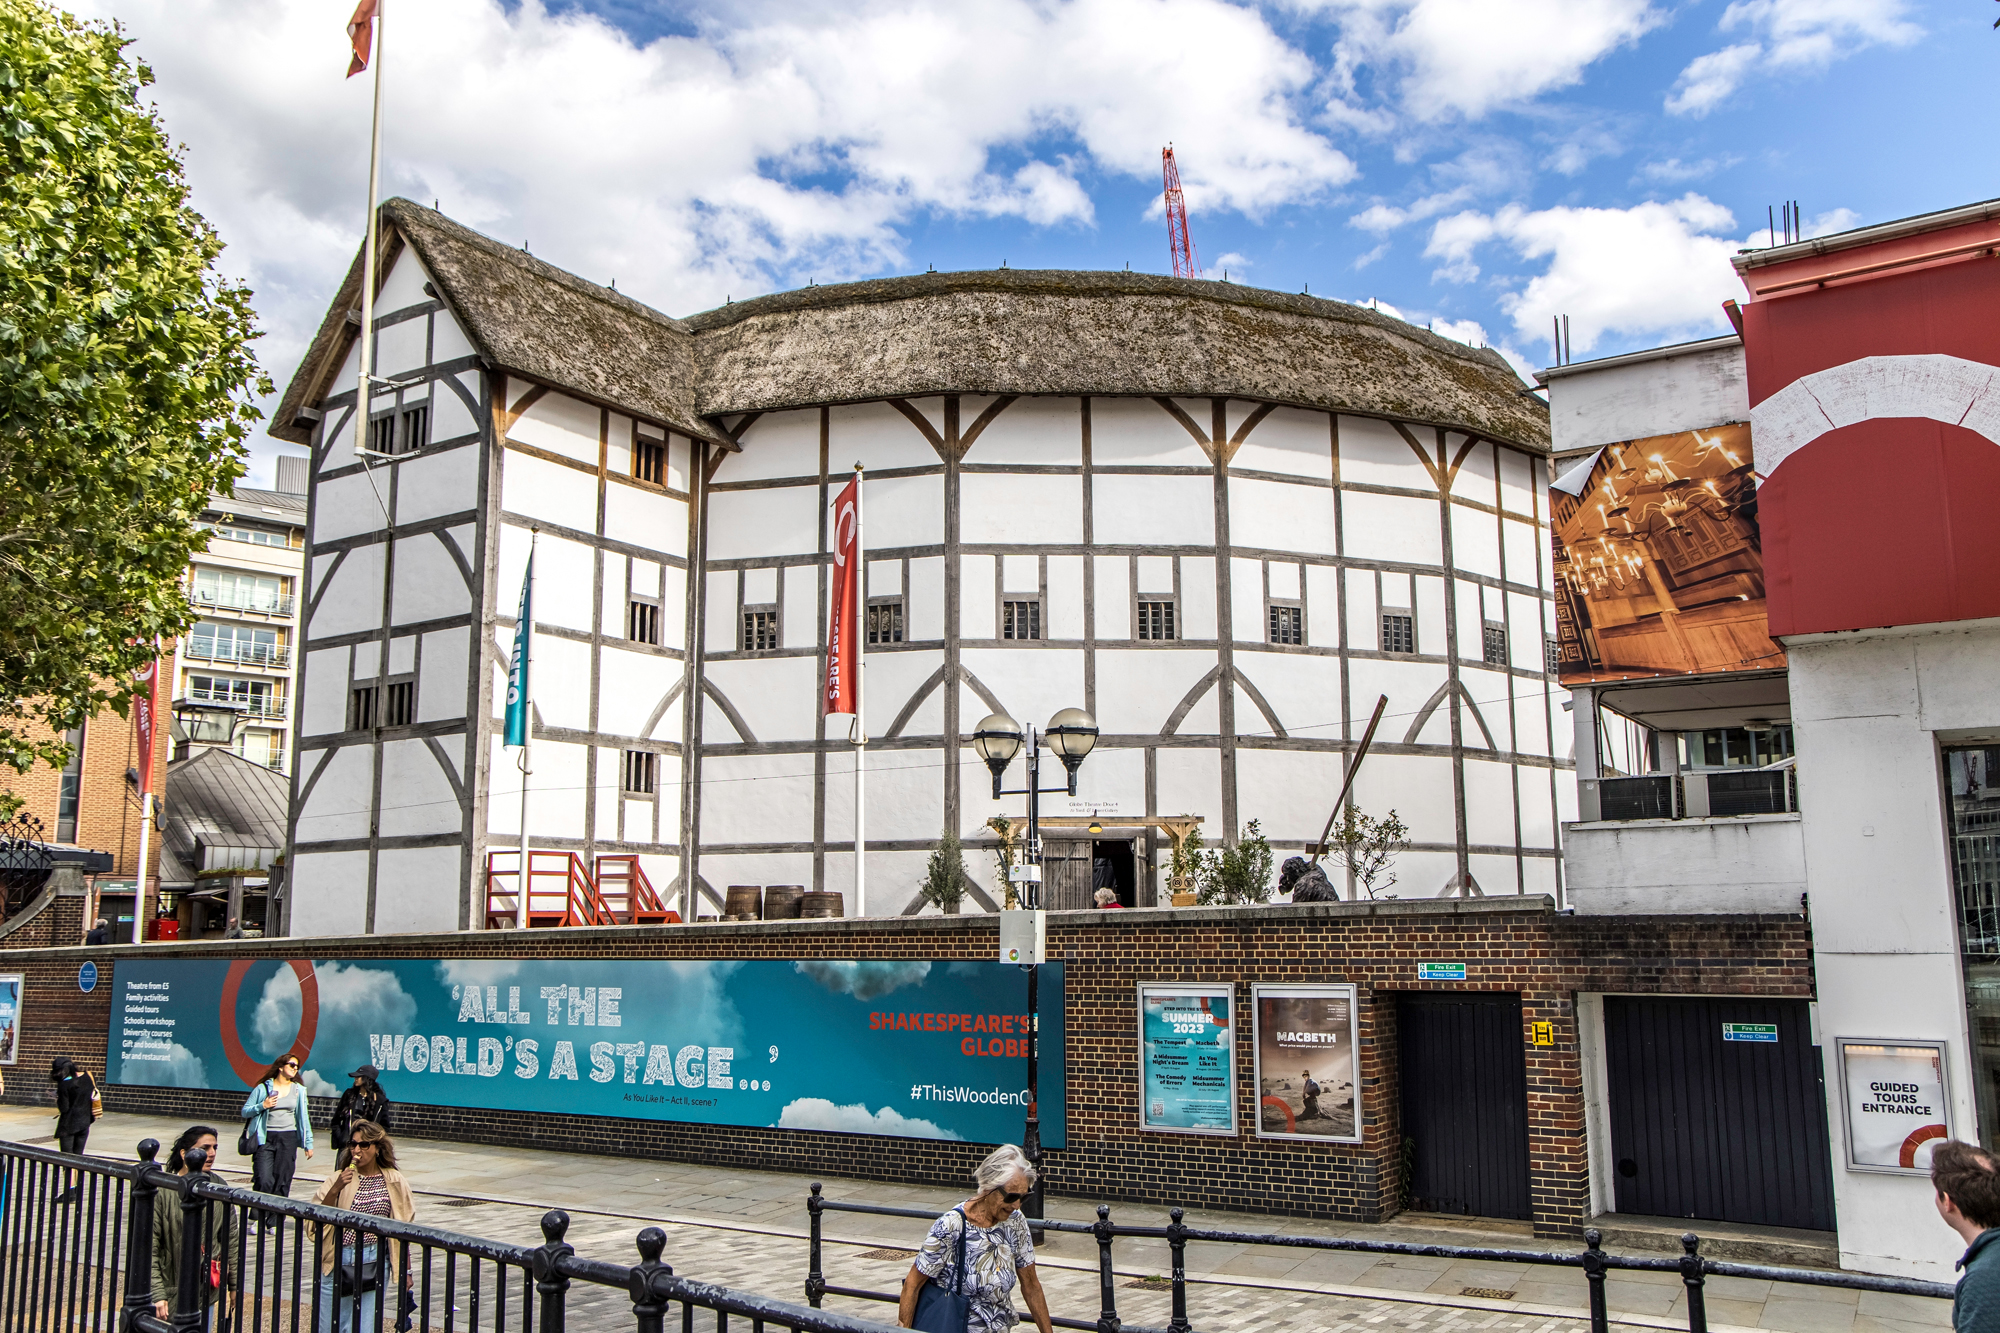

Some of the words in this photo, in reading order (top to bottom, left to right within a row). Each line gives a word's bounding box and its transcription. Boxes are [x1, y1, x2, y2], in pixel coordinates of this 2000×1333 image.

[507, 643, 521, 706] INTO
[127, 981, 148, 990] Theatre
[148, 982, 162, 990] from
[162, 982, 170, 990] £5
[125, 993, 143, 1003] Family
[143, 994, 169, 1002] activities
[125, 1005, 145, 1013] Guided
[540, 983, 622, 1027] THE
[124, 1016, 145, 1025] Schools
[145, 1017, 176, 1027] workshops
[1161, 1012, 1215, 1024] SUMMER
[123, 1028, 150, 1038] University
[151, 1030, 173, 1038] courses
[1173, 1023, 1204, 1034] 2023
[1276, 1031, 1337, 1043] MACBETH
[122, 1039, 133, 1048] Gift
[144, 1041, 171, 1051] bookshop
[961, 1037, 1029, 1058] GLOBE
[121, 1051, 131, 1060] Bar
[131, 1052, 142, 1060] and
[142, 1053, 171, 1061] restaurant
[370, 1033, 540, 1080] WORLD’S
[548, 1040, 579, 1081] A
[1870, 1081, 1919, 1093] GUIDED
[623, 1093, 632, 1102] As
[633, 1093, 645, 1103] You
[645, 1094, 658, 1104] Like
[659, 1095, 665, 1104] It
[670, 1096, 683, 1105] Act
[691, 1098, 712, 1107] scene
[713, 1098, 718, 1107] 7
[1873, 1092, 1917, 1104] TOURS
[1862, 1103, 1932, 1116] ENTRANCE
